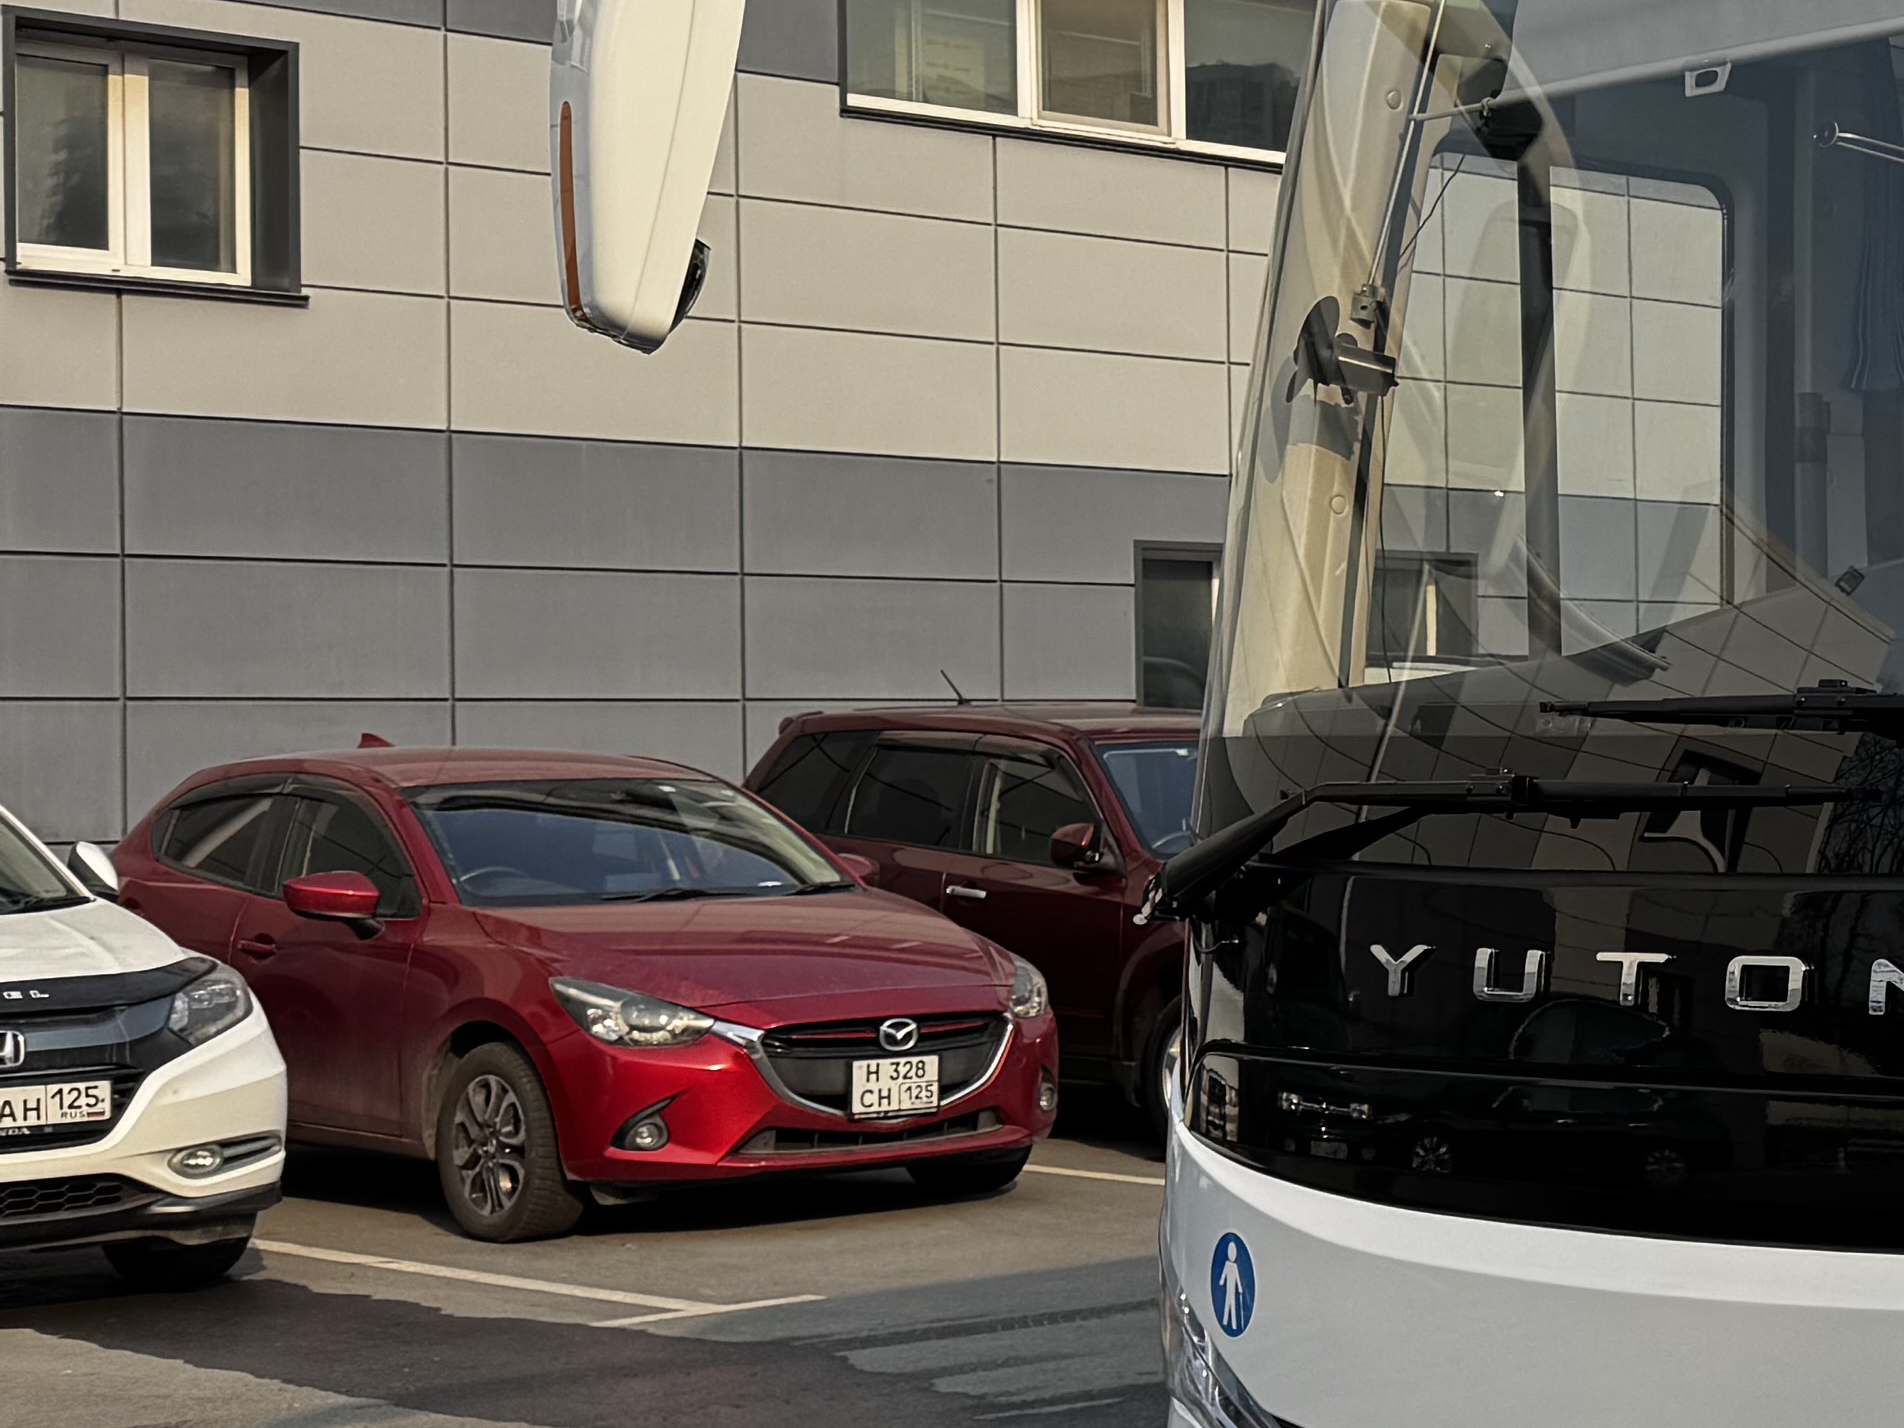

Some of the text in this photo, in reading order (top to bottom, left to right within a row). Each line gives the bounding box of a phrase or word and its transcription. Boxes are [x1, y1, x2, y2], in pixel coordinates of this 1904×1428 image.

[889, 1060, 926, 1081] 328
[51, 1085, 100, 1110] 125
[904, 1083, 934, 1100] 125
[61, 1110, 87, 1119] RUS
